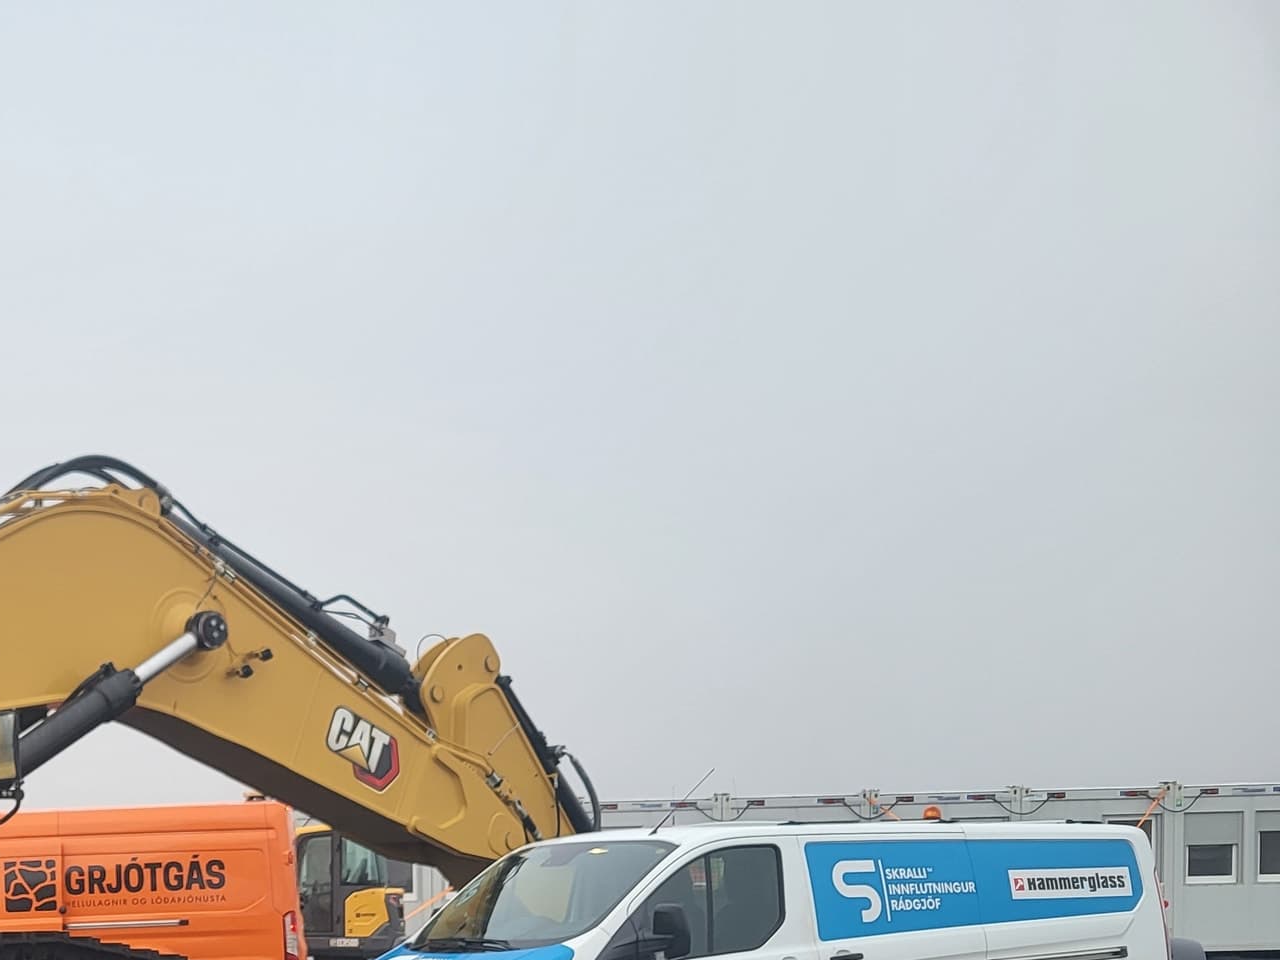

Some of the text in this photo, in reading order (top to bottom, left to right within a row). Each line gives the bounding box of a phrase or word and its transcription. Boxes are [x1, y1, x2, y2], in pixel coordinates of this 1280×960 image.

[327, 708, 391, 774] CAT
[65, 854, 226, 896] GRJÓTGÁS
[1027, 873, 1126, 892] Hammerglass
[888, 881, 976, 896] INNFLUTNINGUR
[131, 896, 147, 906] OG
